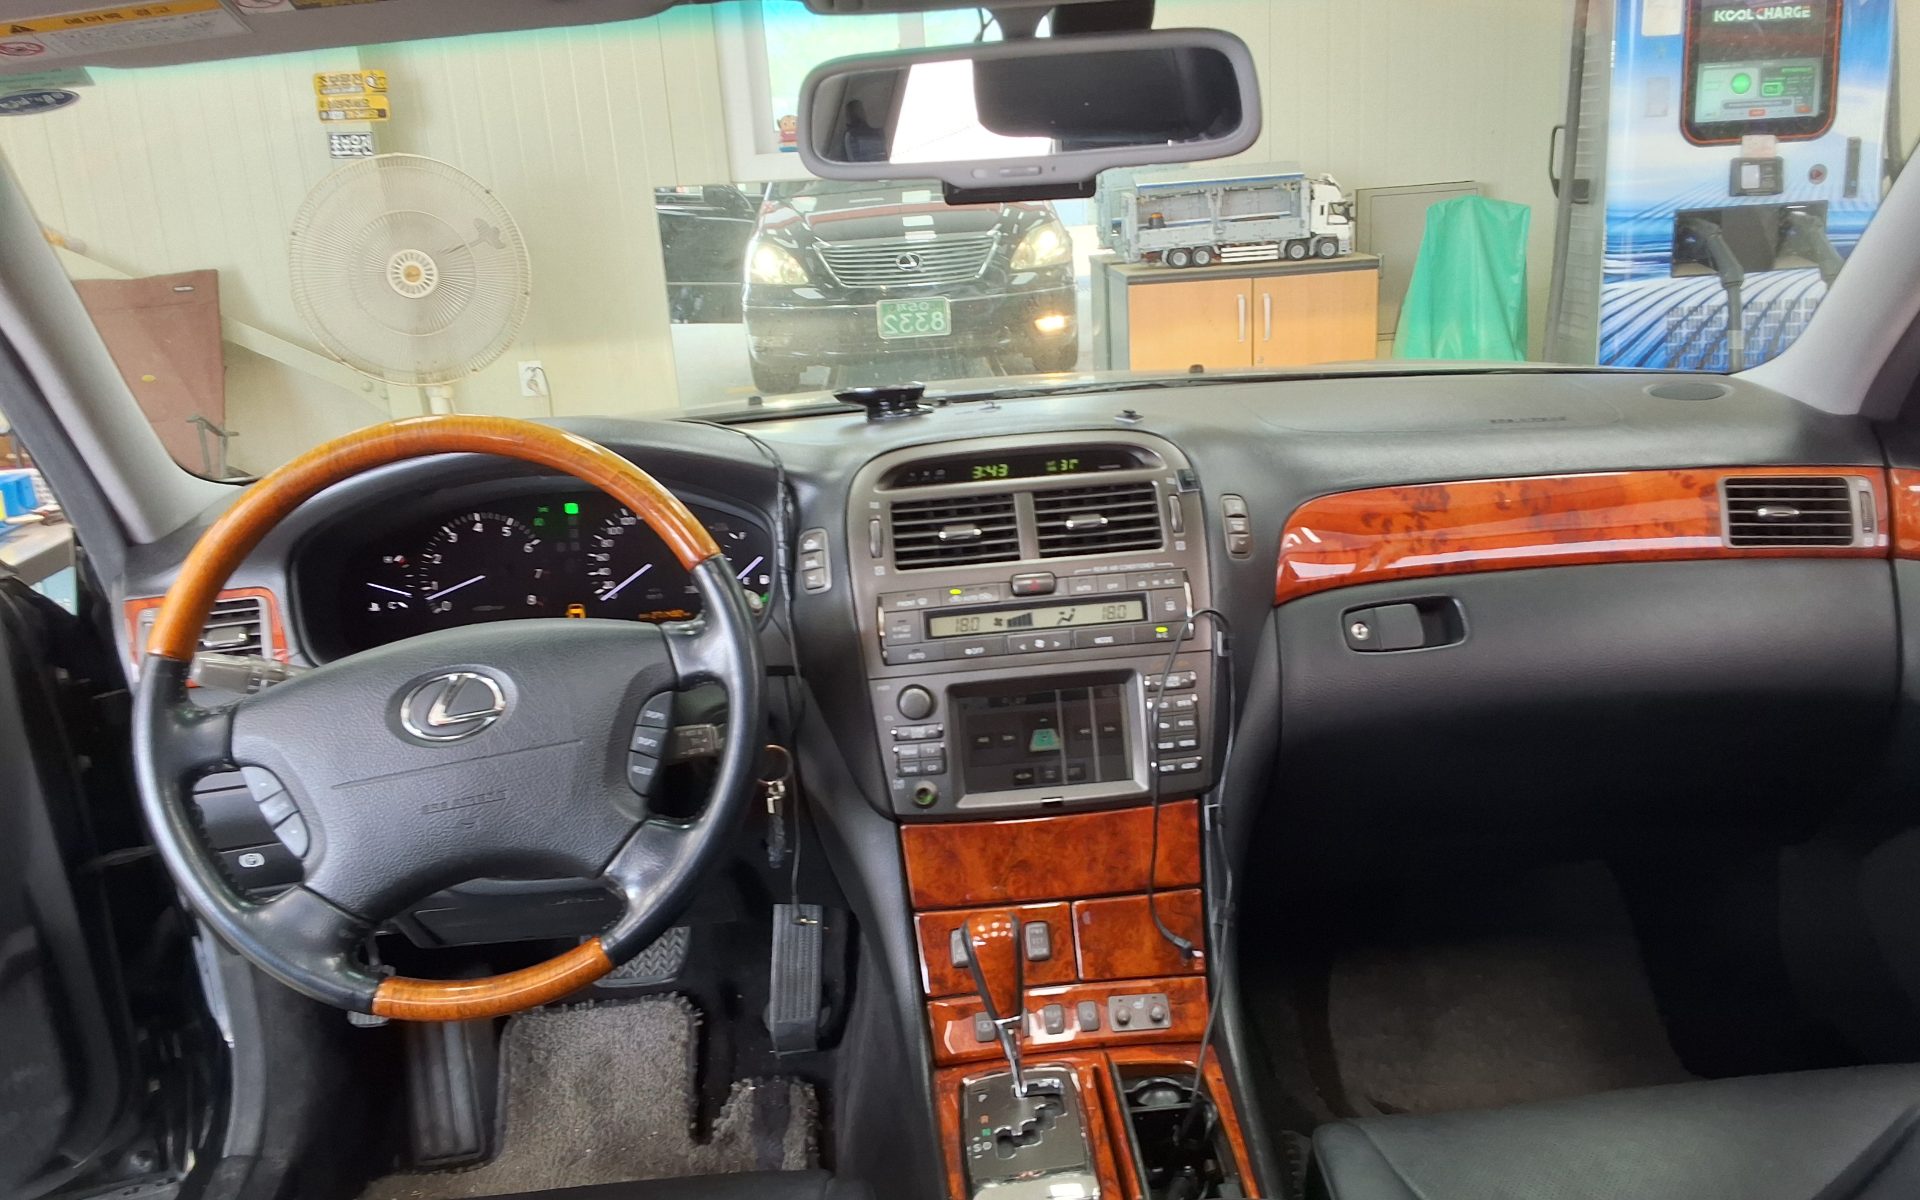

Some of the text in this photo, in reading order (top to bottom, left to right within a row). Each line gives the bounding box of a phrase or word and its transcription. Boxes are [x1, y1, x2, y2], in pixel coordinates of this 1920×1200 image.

[1714, 6, 1811, 22] KOOL CHARGE
[502, 526, 512, 537] 5
[448, 532, 458, 543] 3
[524, 542, 534, 553] 6
[433, 553, 443, 565] 2
[534, 568, 543, 579] 7
[527, 594, 537, 605] 8
